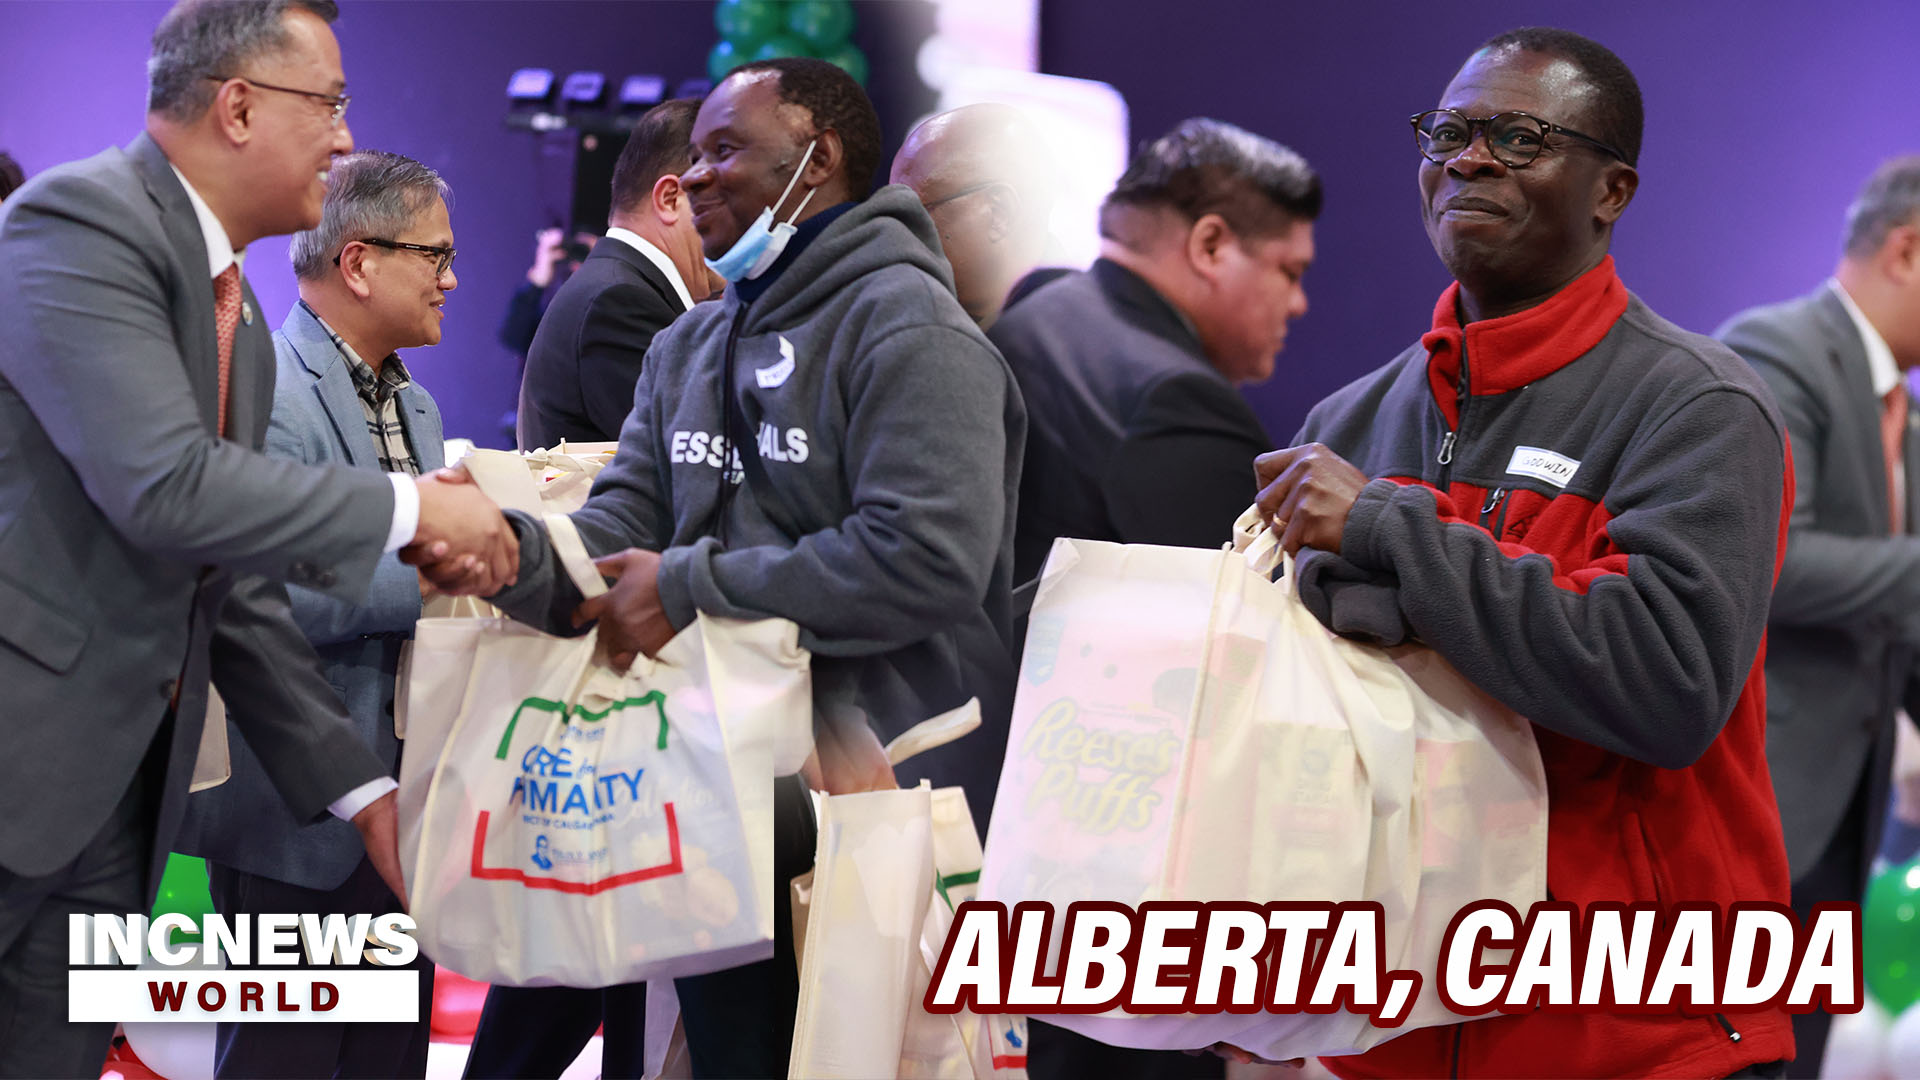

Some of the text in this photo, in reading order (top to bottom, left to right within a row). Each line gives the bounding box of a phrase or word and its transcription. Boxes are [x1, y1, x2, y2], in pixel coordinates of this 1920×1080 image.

[1522, 457, 1573, 477] GODWIN
[521, 745, 573, 777] CRE
[1020, 698, 1181, 775] Reese's
[1023, 761, 1161, 833] Puffs
